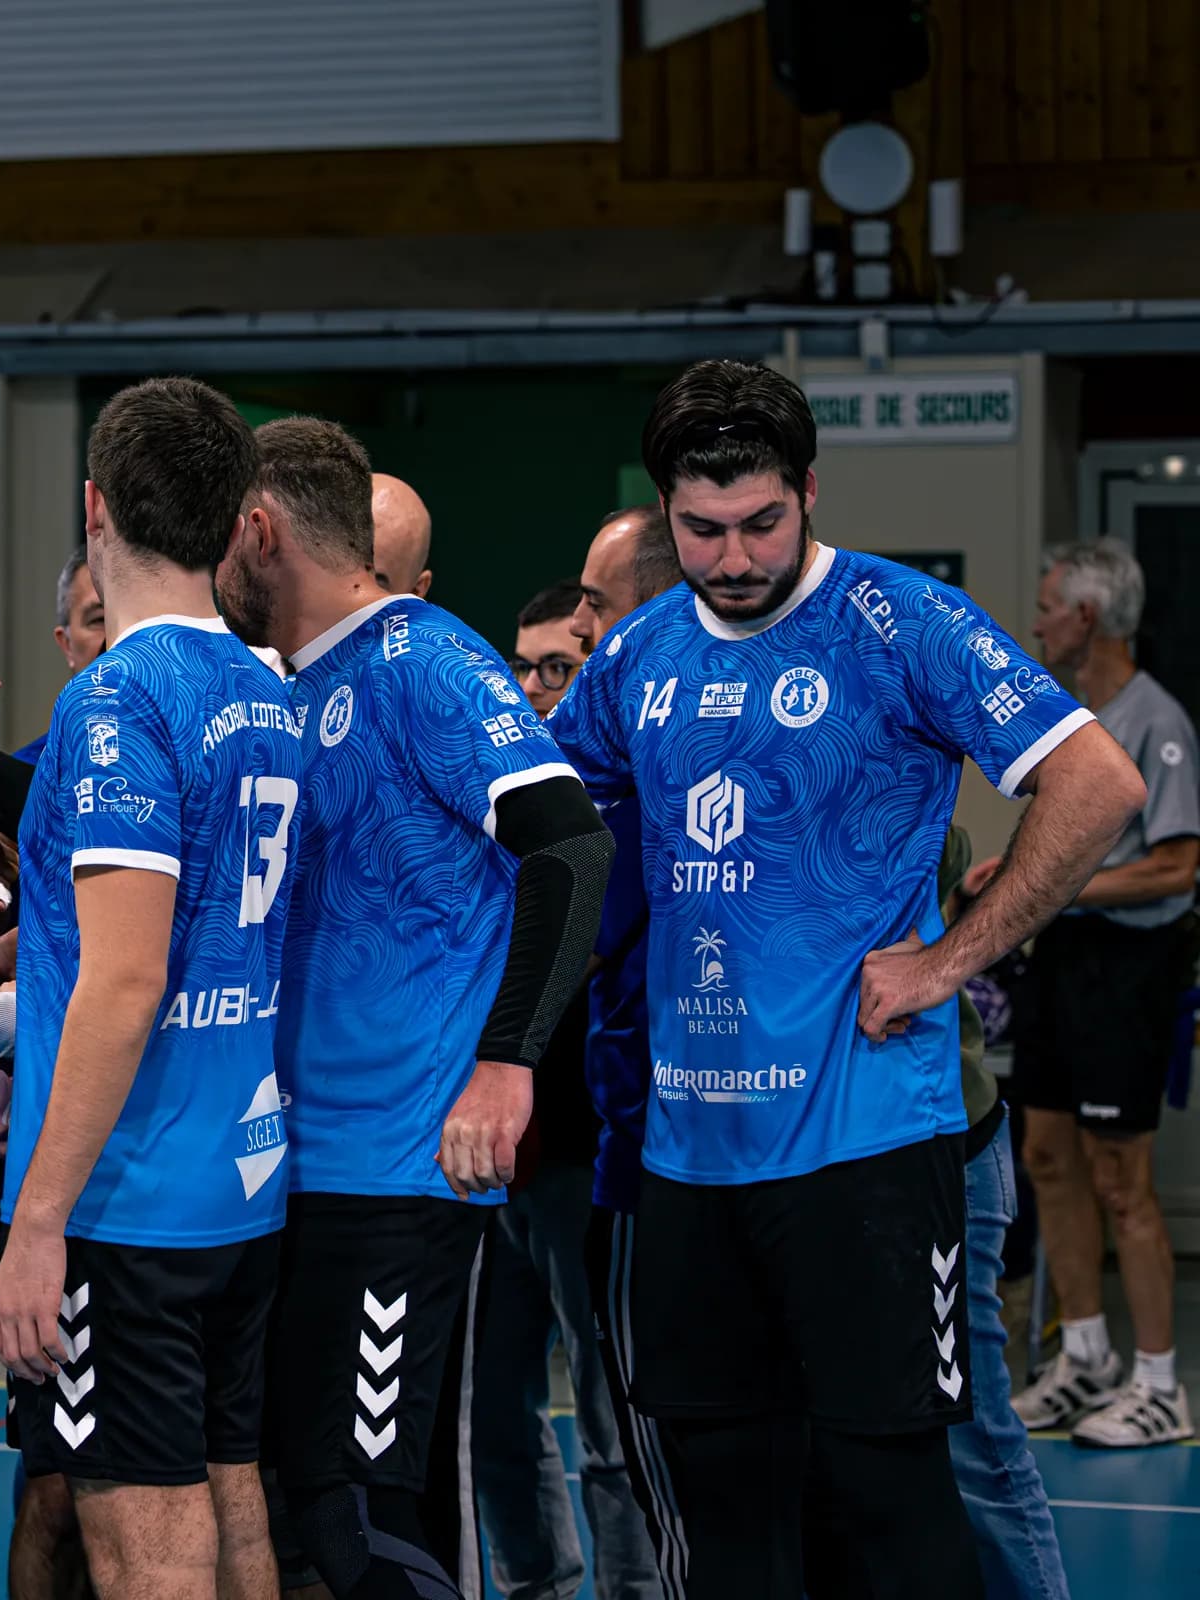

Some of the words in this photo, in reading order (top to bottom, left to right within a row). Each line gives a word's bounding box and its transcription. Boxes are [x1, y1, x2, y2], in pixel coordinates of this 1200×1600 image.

[808, 393, 860, 427] SSUE
[877, 393, 900, 427] DE
[916, 389, 1011, 425] SECOURS
[388, 614, 411, 658] ACPH
[784, 669, 819, 683] HBCB
[719, 695, 743, 705] PLAY
[728, 684, 744, 693] WE
[636, 677, 679, 731] 14
[704, 708, 736, 716] HANDBALL
[251, 702, 283, 731] COTE
[98, 776, 158, 823] Carry
[98, 804, 108, 813] LE
[110, 804, 140, 814] ROUET
[238, 775, 299, 929] 13
[672, 860, 718, 893] STTP
[722, 860, 737, 893] &
[743, 860, 755, 893] P
[677, 996, 749, 1016] MALISA
[688, 1020, 739, 1034] BEACH
